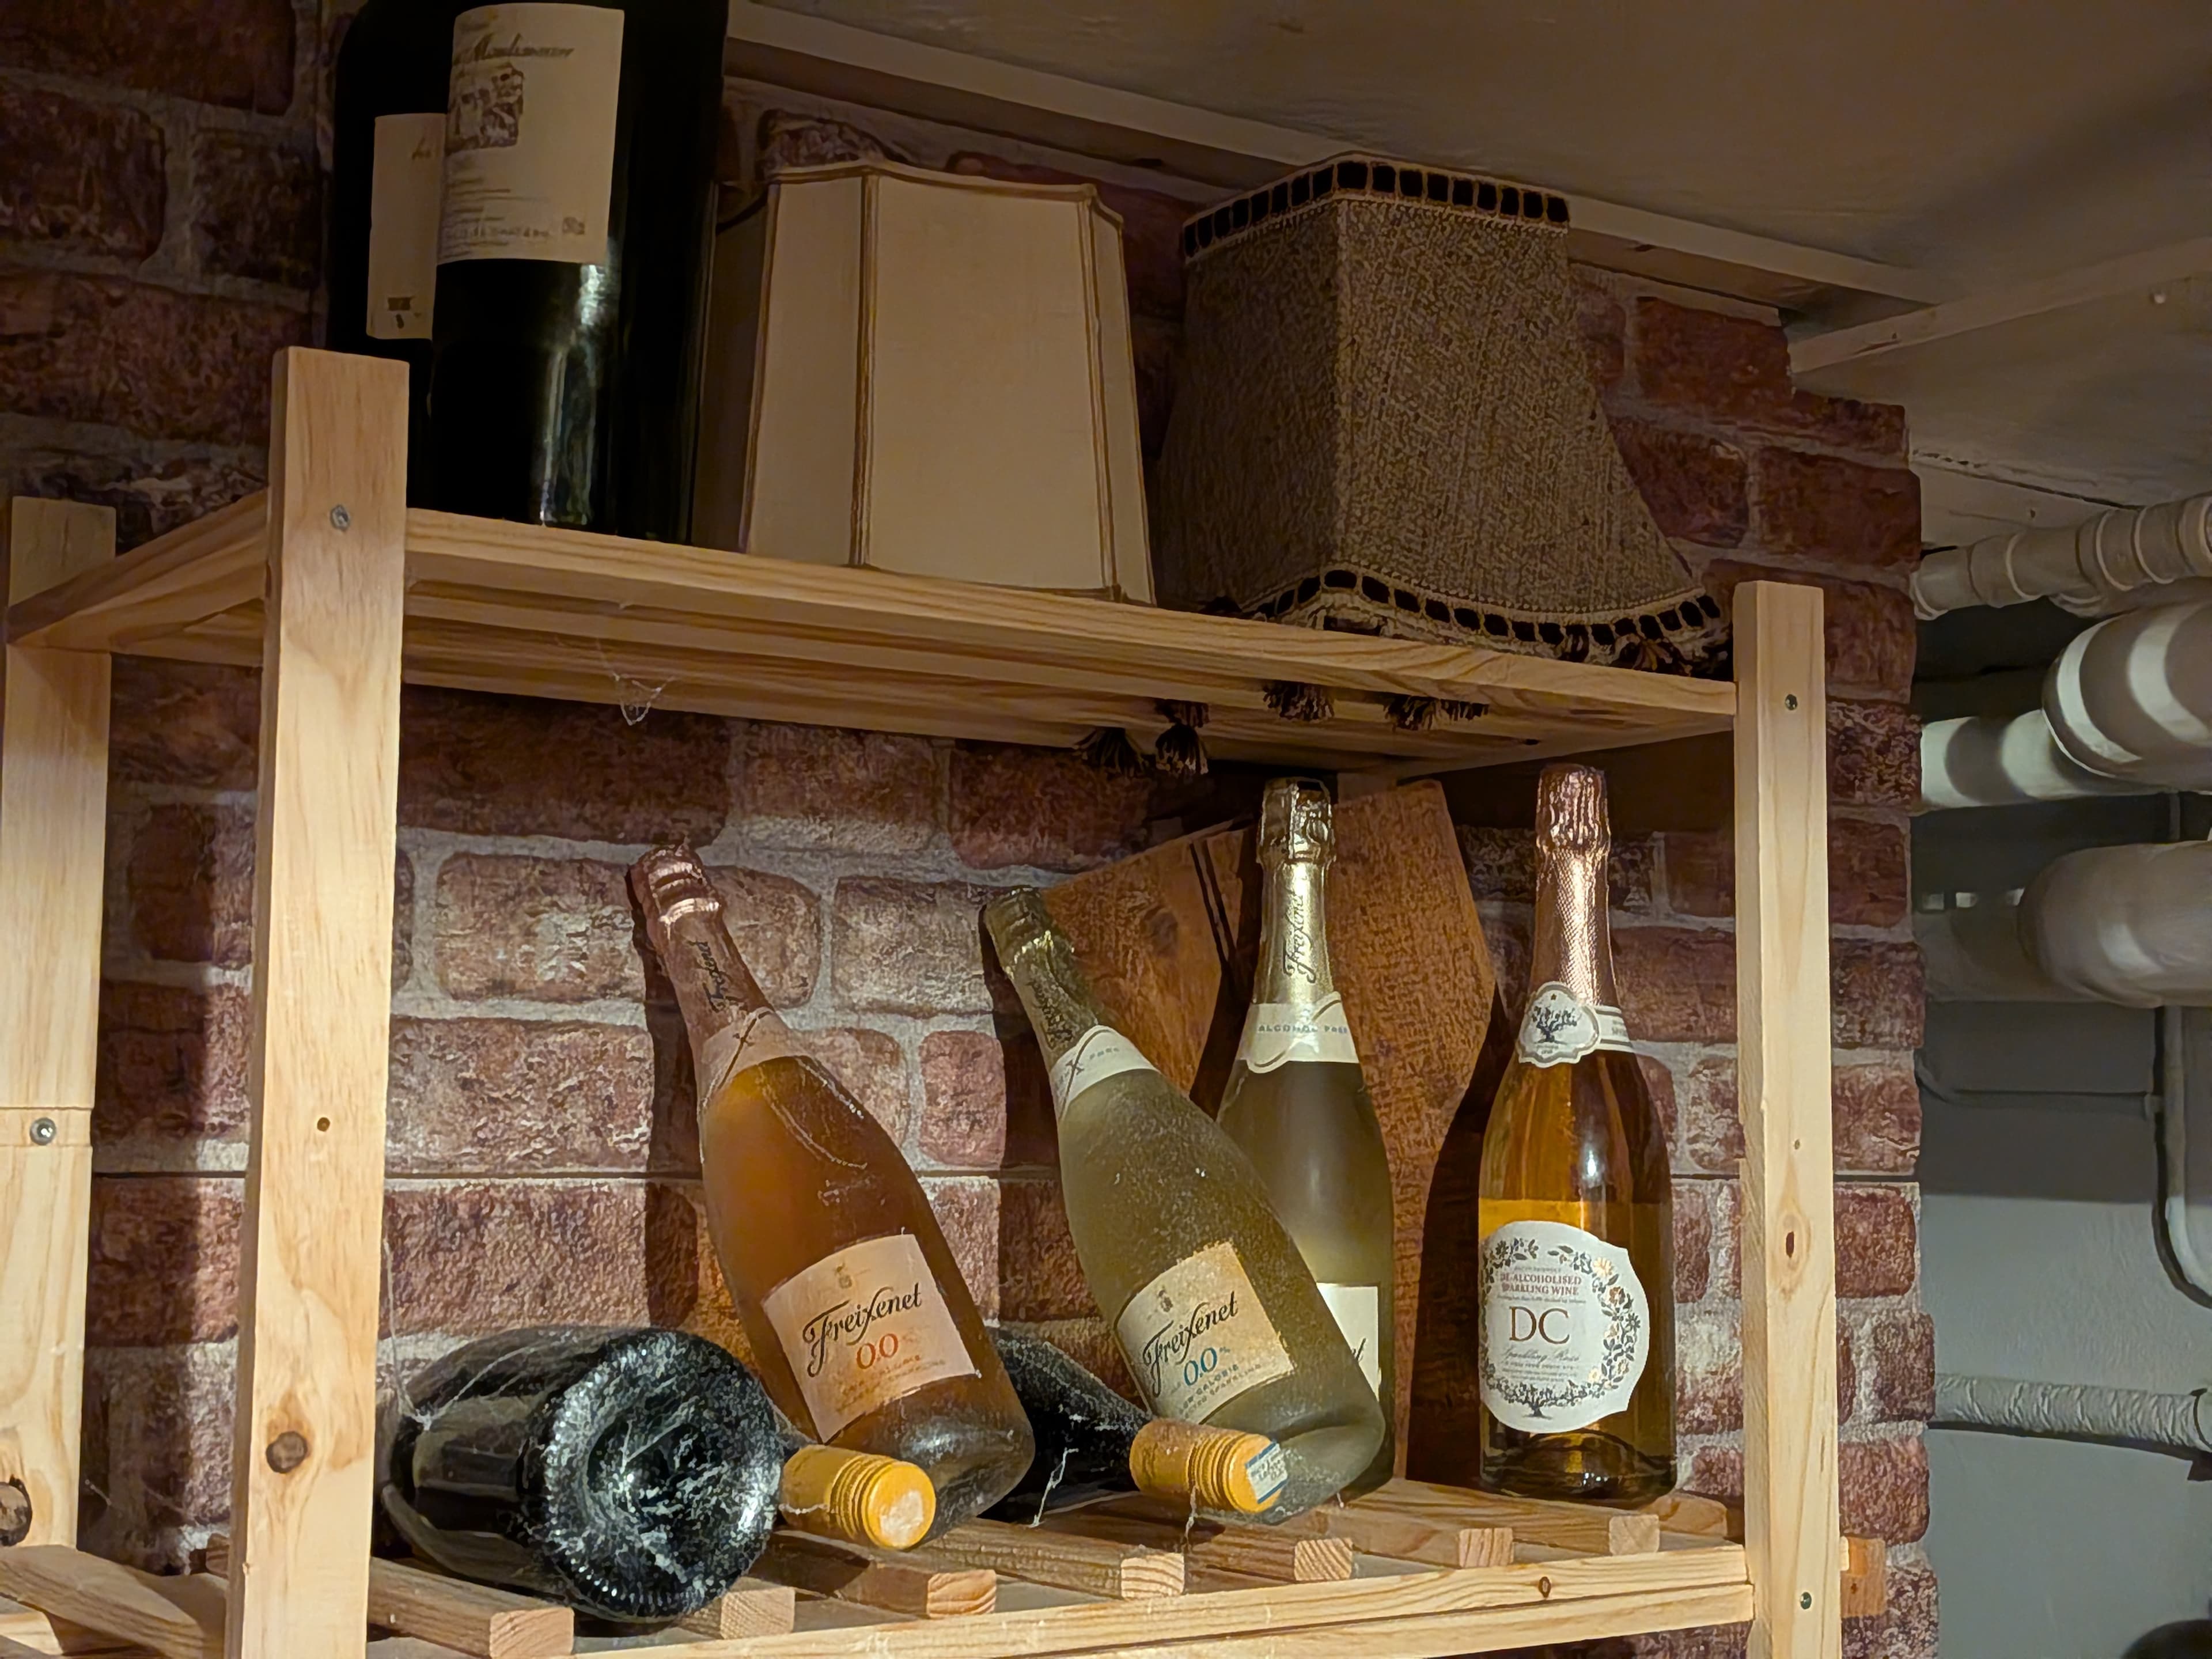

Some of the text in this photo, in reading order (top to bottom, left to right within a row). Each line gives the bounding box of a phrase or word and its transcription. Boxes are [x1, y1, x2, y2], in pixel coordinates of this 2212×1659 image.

[1551, 1285, 1579, 1296] WINE
[802, 1282, 922, 1378] Freixenet
[1143, 1290, 1238, 1398] Freixenet
[1508, 1305, 1571, 1345] DC
